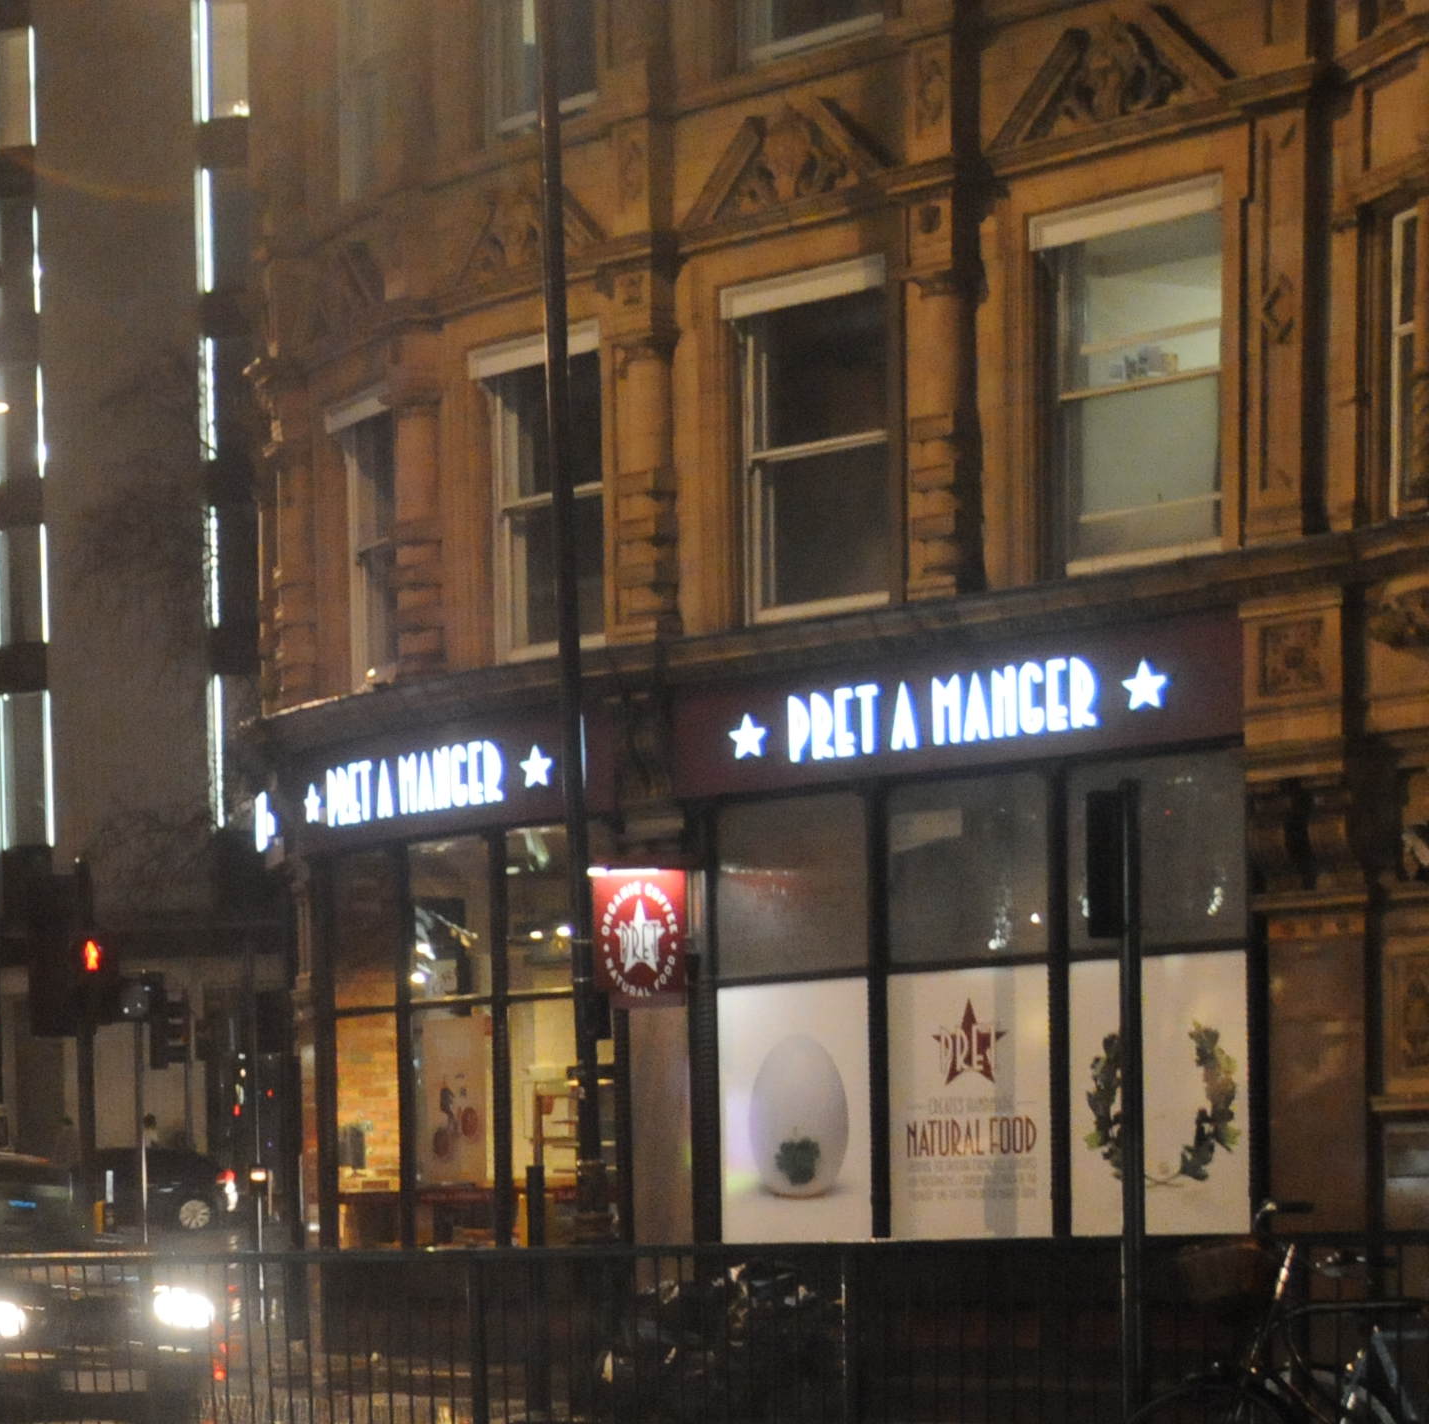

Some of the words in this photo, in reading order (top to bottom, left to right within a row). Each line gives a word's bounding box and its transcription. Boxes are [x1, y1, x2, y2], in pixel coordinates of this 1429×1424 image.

[787, 683, 879, 763] PRET
[890, 680, 918, 751] A
[931, 656, 1098, 746] MANGER
[326, 760, 373, 828] PRET
[377, 758, 394, 819] A
[398, 740, 505, 815] MANGER
[602, 881, 641, 936] ORGANIC
[644, 882, 678, 935] COFFEE
[619, 920, 659, 963] PRET
[605, 957, 651, 997] NATURAL
[653, 955, 676, 991] FOOD
[940, 1023, 997, 1074] PRET
[907, 1117, 984, 1158] NATURAL
[989, 1115, 1038, 1154] FOOD
